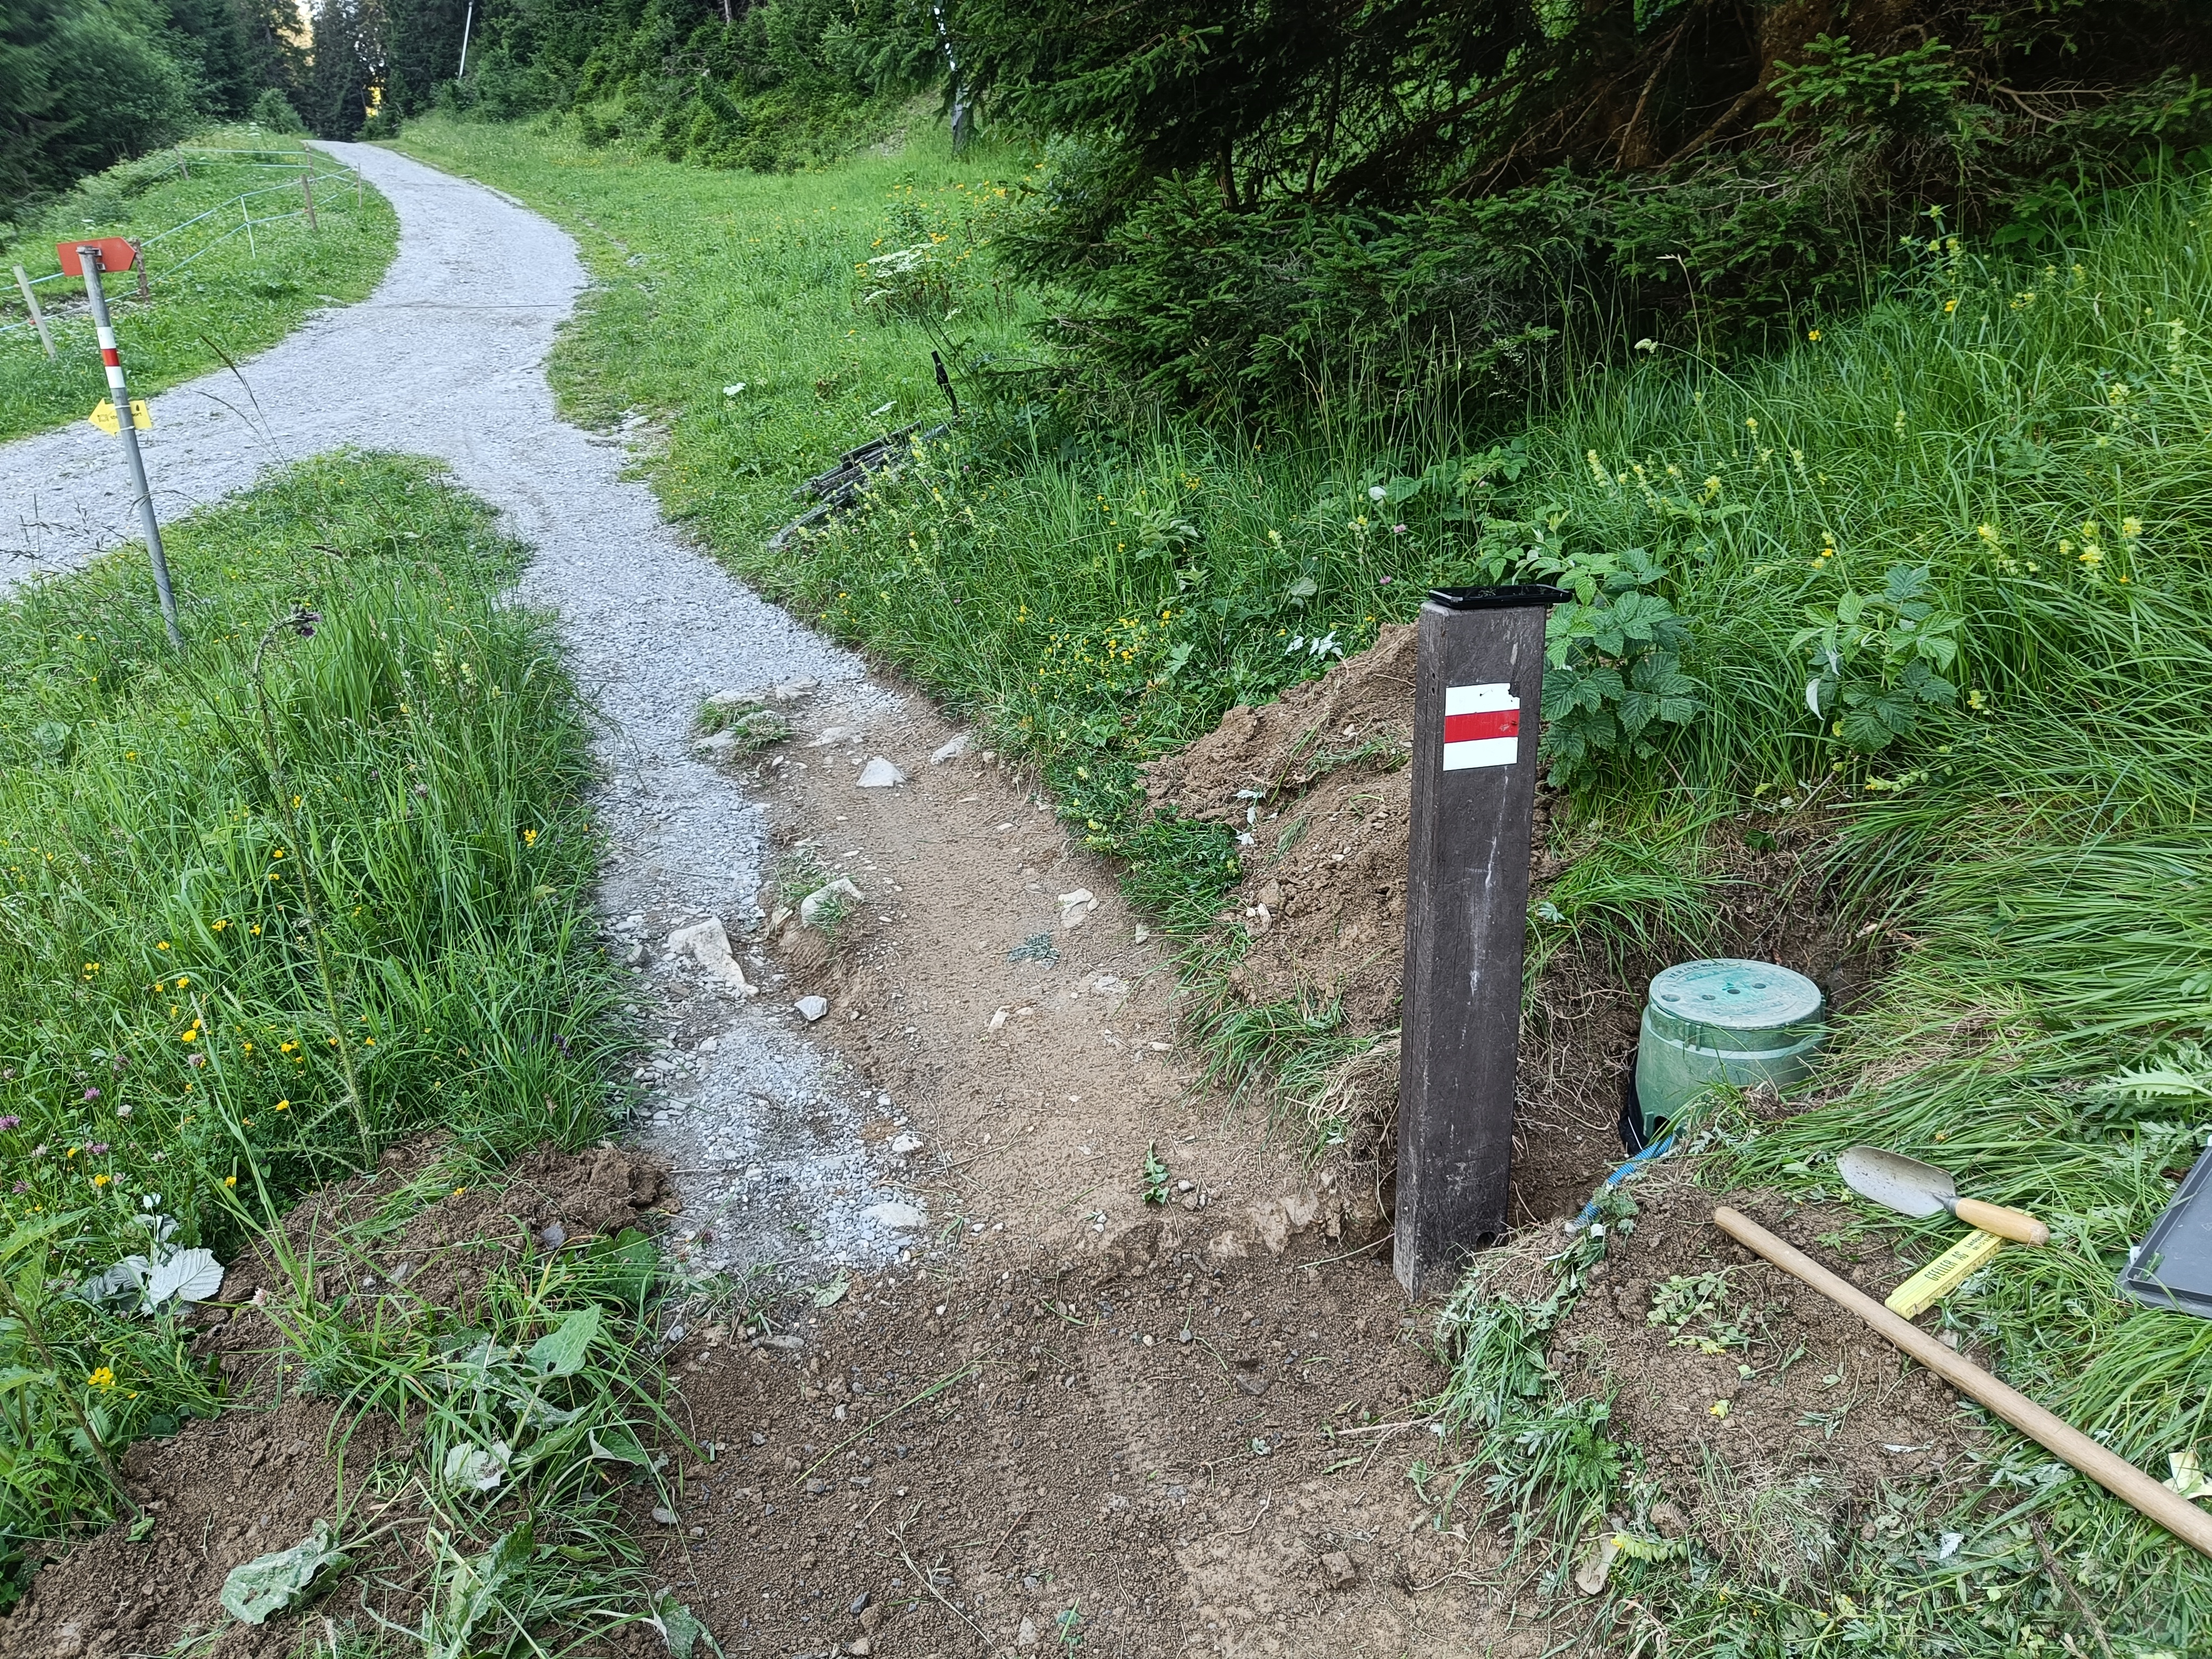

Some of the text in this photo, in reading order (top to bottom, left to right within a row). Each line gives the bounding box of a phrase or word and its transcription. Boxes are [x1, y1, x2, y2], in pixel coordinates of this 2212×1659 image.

[1964, 1231, 1988, 1248] Landquart
[1924, 1259, 1958, 1281] GFELLER
[1951, 1251, 1969, 1261] AG
